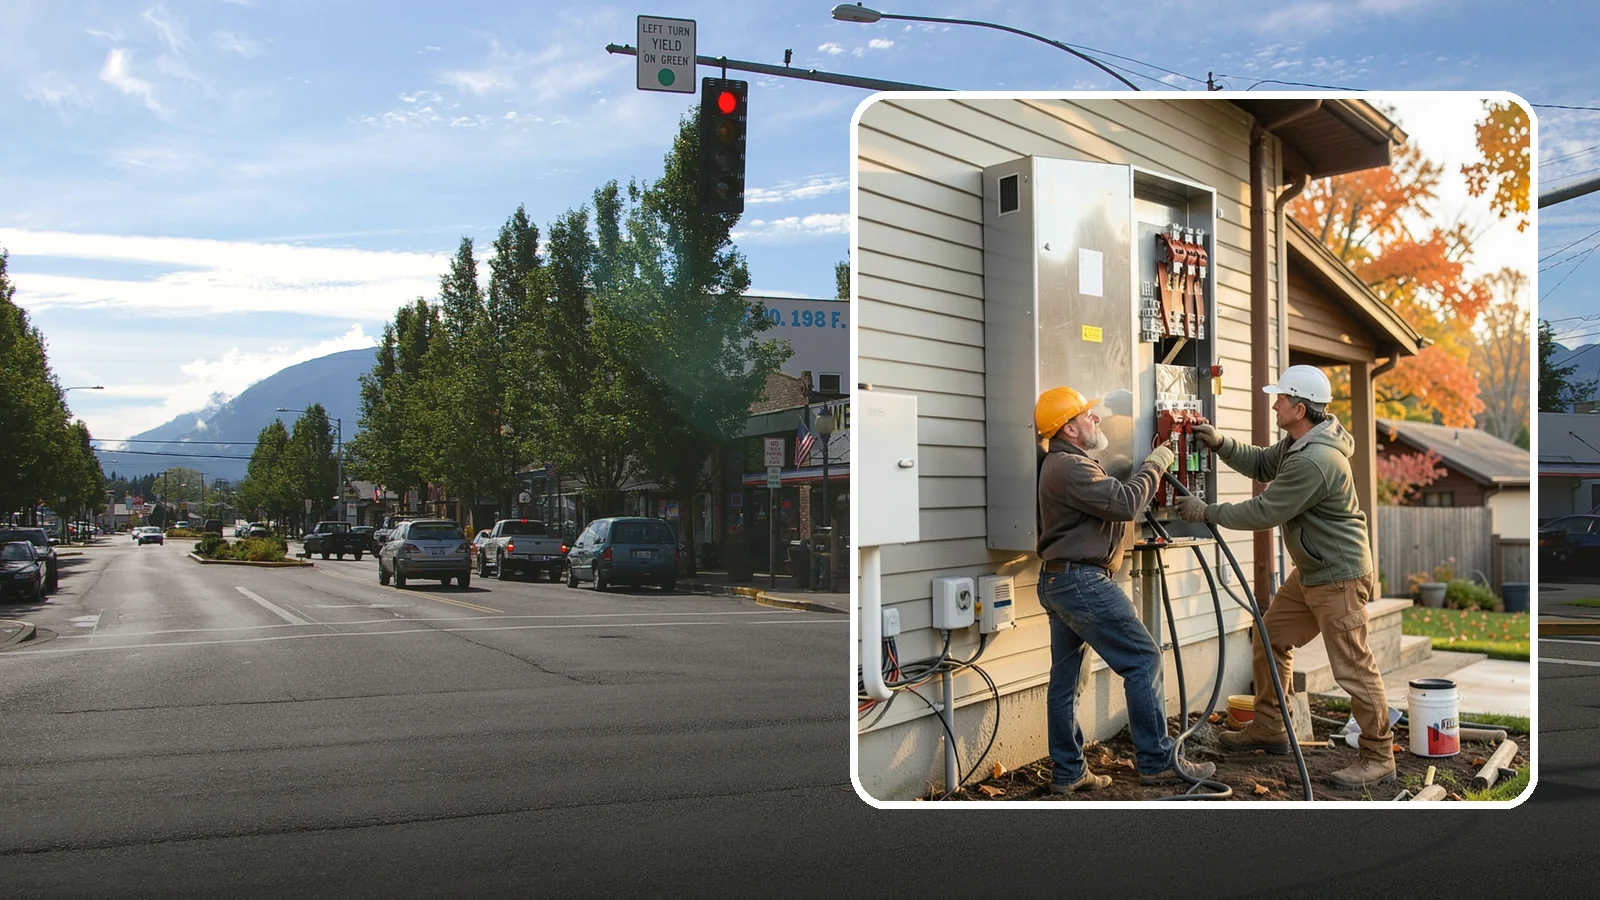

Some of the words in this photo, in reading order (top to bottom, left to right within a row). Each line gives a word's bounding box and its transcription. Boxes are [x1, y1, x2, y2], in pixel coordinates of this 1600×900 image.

[643, 24, 663, 34] LEFT
[668, 26, 690, 37] TURN
[652, 38, 682, 52] YIELD
[644, 53, 656, 63] ON
[661, 55, 689, 66] GREEN
[791, 309, 826, 328] 198
[831, 311, 847, 329] F.
